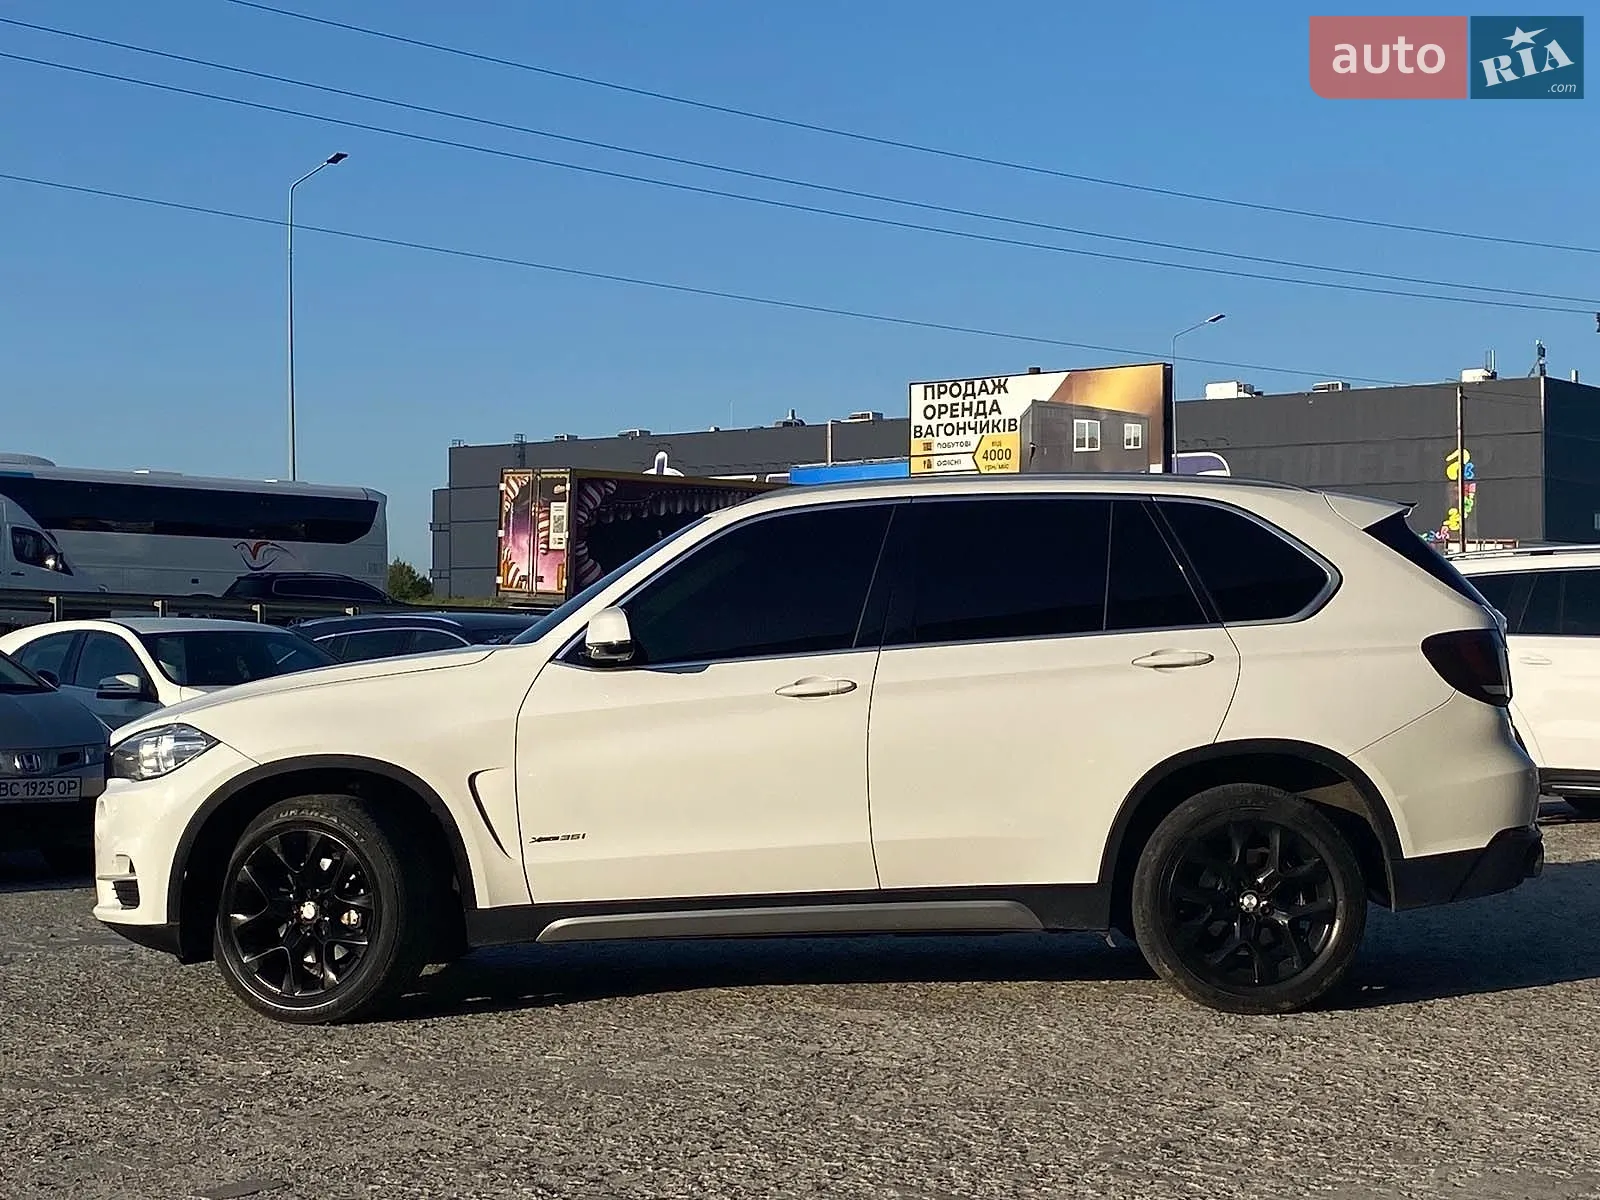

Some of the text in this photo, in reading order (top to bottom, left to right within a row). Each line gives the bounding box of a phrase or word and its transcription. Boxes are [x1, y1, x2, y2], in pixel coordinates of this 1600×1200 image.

[923, 378, 1008, 400] ПРОДАЖ
[923, 399, 1002, 420] ОРЕНДА
[913, 418, 1018, 439] ВАГОНЧИКІВ
[982, 448, 1012, 461] 4000
[0, 780, 77, 797] BC 1925 OP
